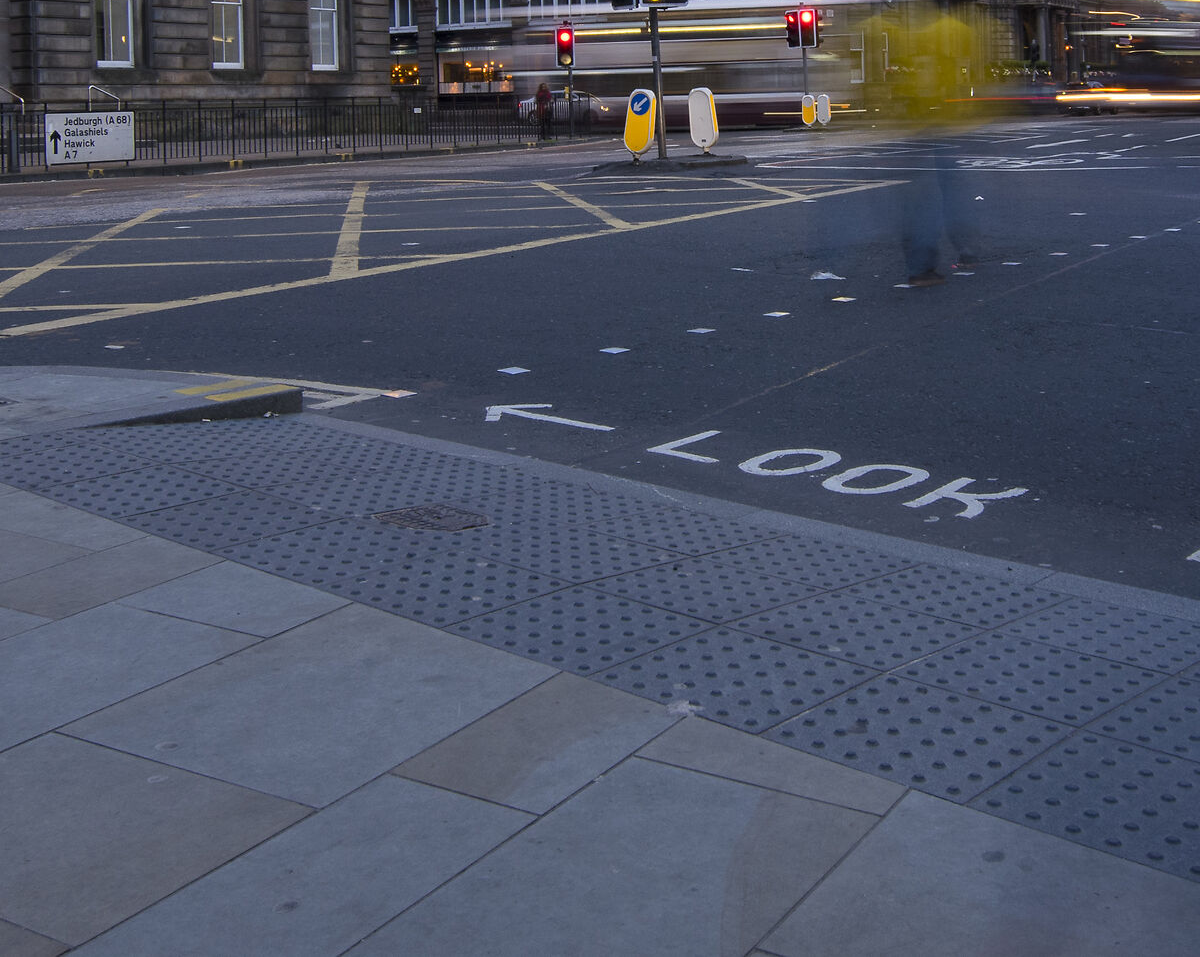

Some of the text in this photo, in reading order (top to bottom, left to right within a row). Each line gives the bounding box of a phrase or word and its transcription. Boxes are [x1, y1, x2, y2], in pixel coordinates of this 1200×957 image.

[64, 116, 103, 127] Jedburgh
[64, 127, 108, 137] Galashiels
[64, 138, 95, 148] Hawick
[645, 429, 1028, 520] LOOK
